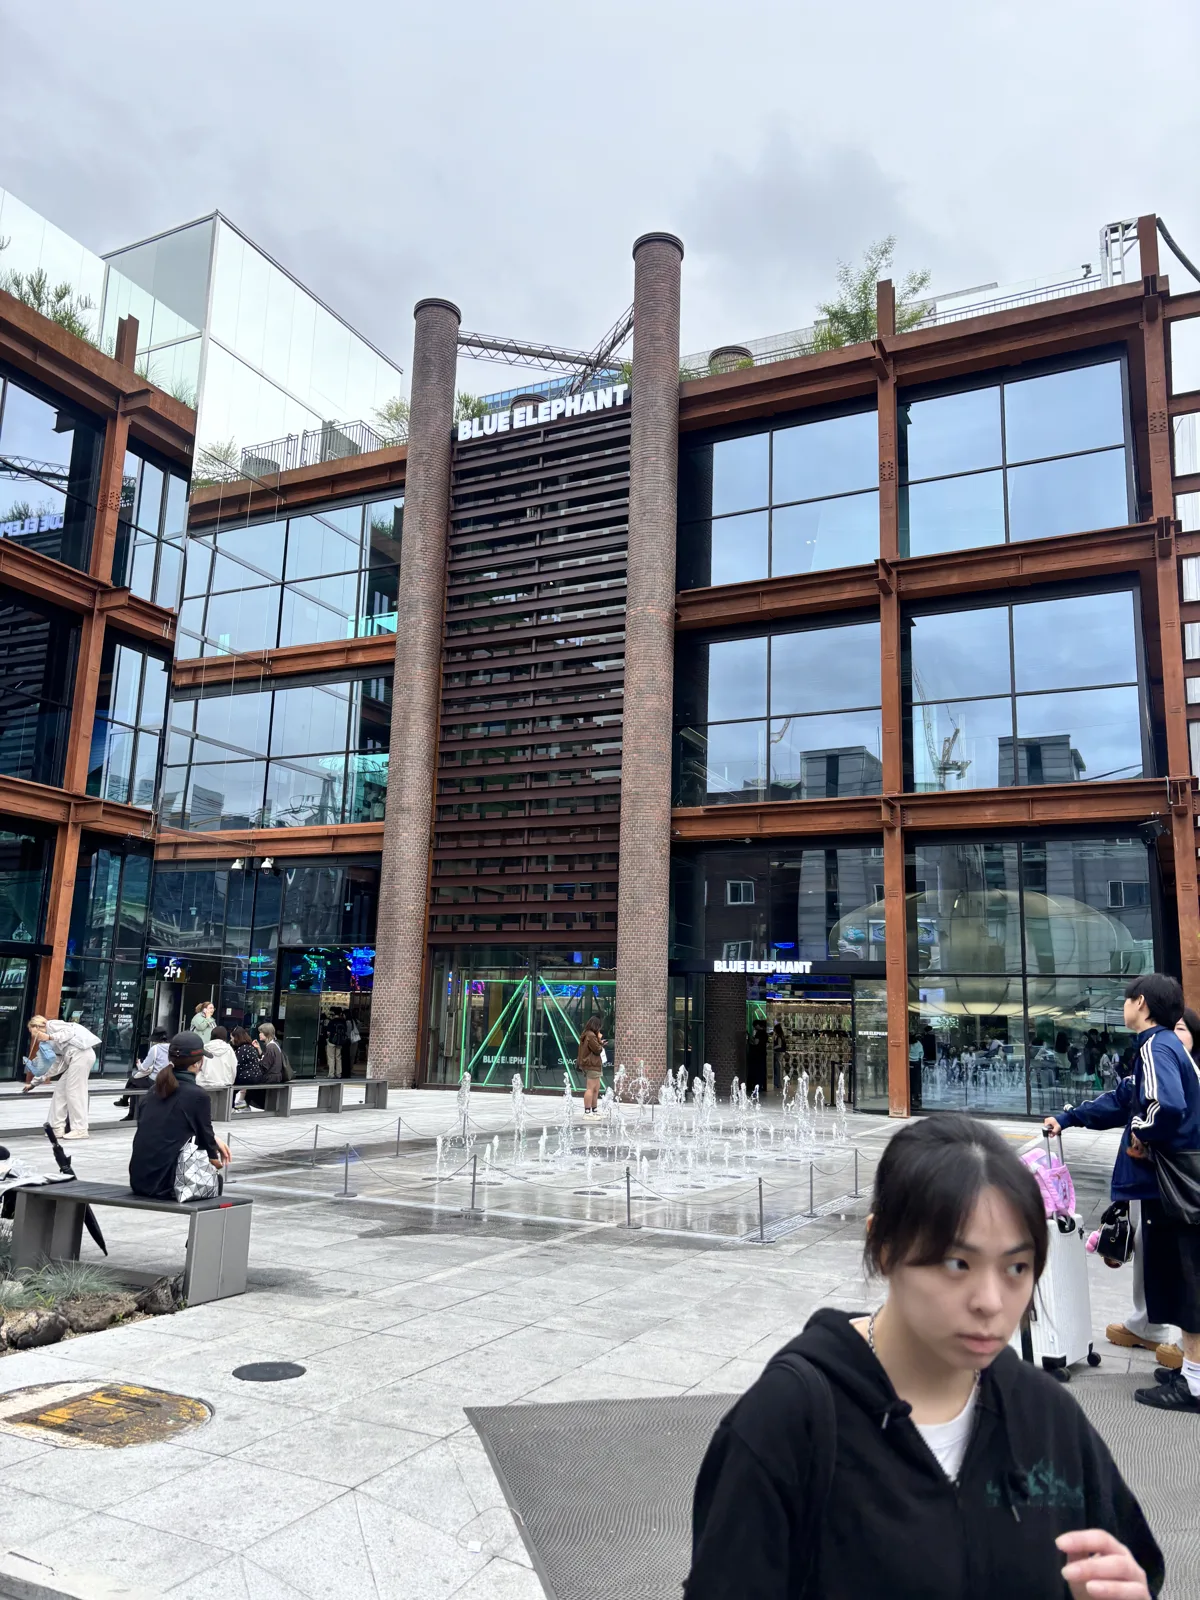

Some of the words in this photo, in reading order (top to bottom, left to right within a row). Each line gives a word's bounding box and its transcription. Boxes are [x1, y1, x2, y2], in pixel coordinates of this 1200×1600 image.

[458, 411, 510, 441] BLUE
[513, 384, 628, 429] ELEPHANT
[163, 965, 177, 978] 2F
[713, 960, 746, 973] BLUE
[746, 961, 812, 973] ELEPHANT
